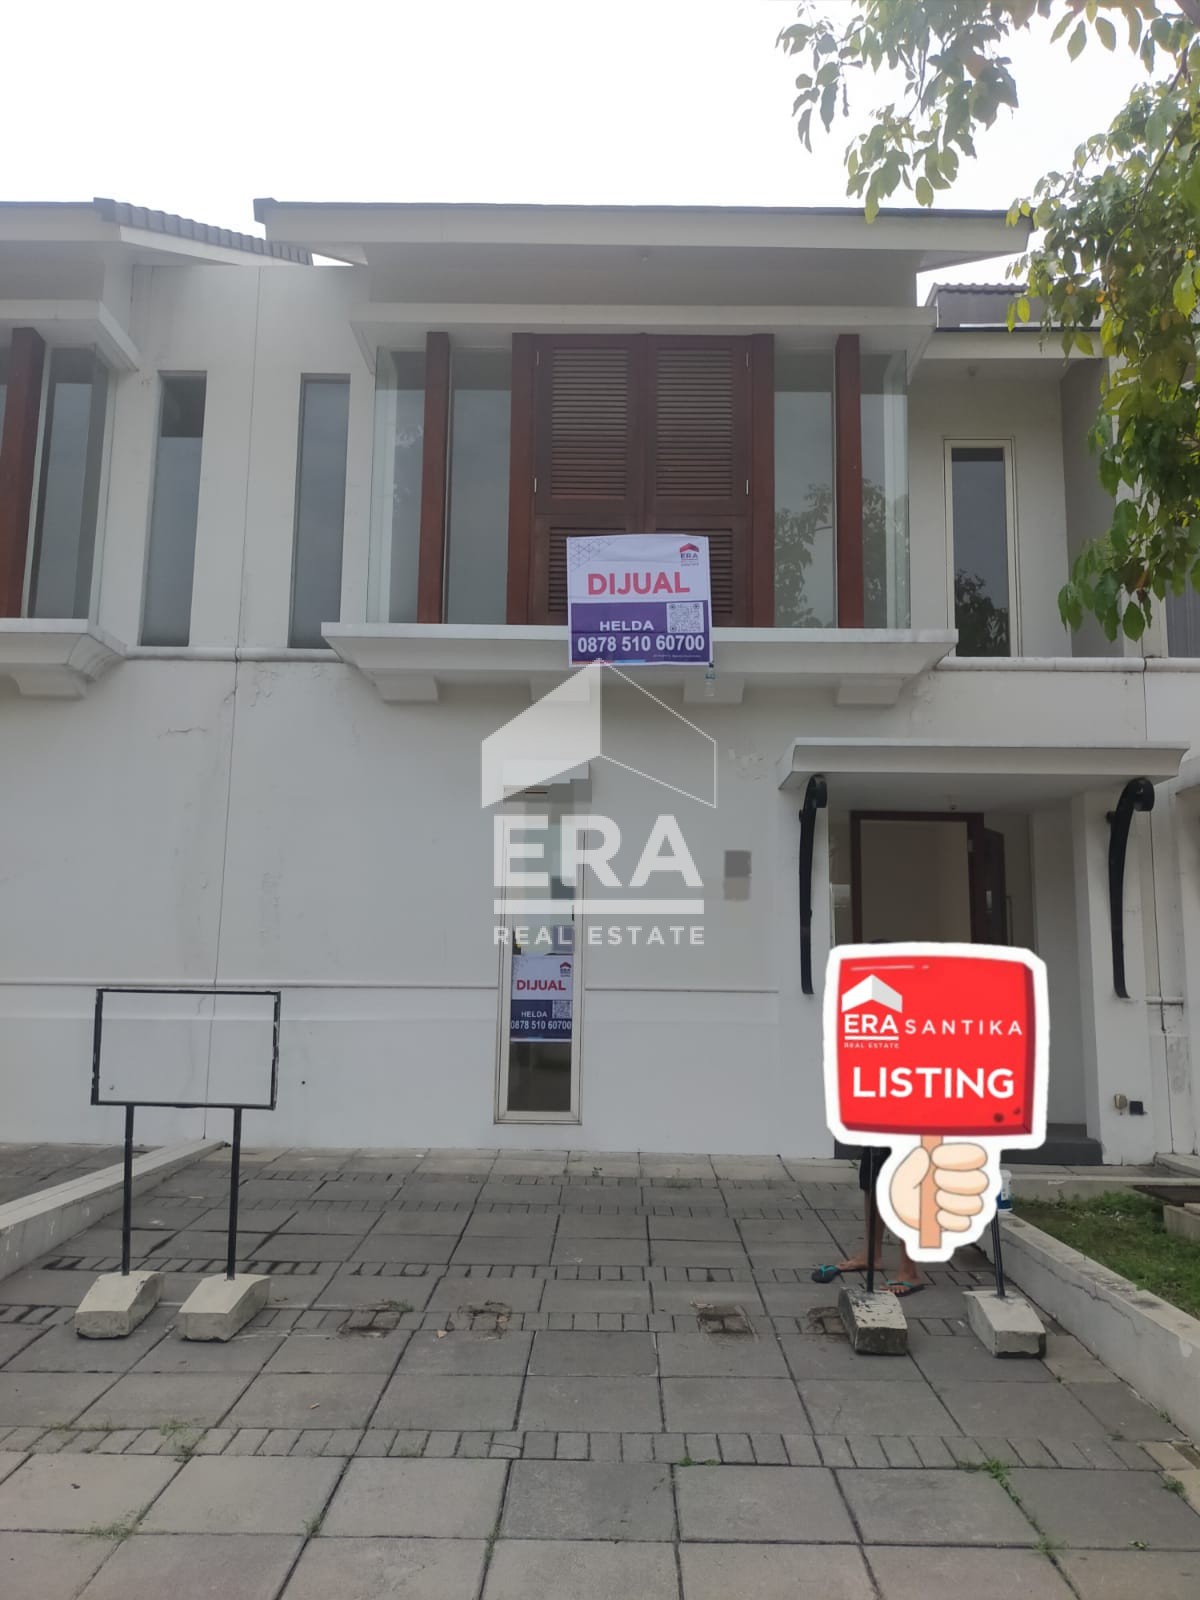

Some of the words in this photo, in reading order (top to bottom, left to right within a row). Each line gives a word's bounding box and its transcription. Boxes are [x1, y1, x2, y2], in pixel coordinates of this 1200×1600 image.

[588, 572, 690, 595] DIJUAL
[599, 620, 654, 632] HELDA
[578, 637, 617, 653] 0878
[621, 636, 651, 651] 510
[656, 635, 704, 651] 60700
[516, 980, 566, 991] DIJUAL
[511, 1020, 529, 1029] 0878
[532, 1020, 545, 1029] 510
[548, 1020, 571, 1029] 60700
